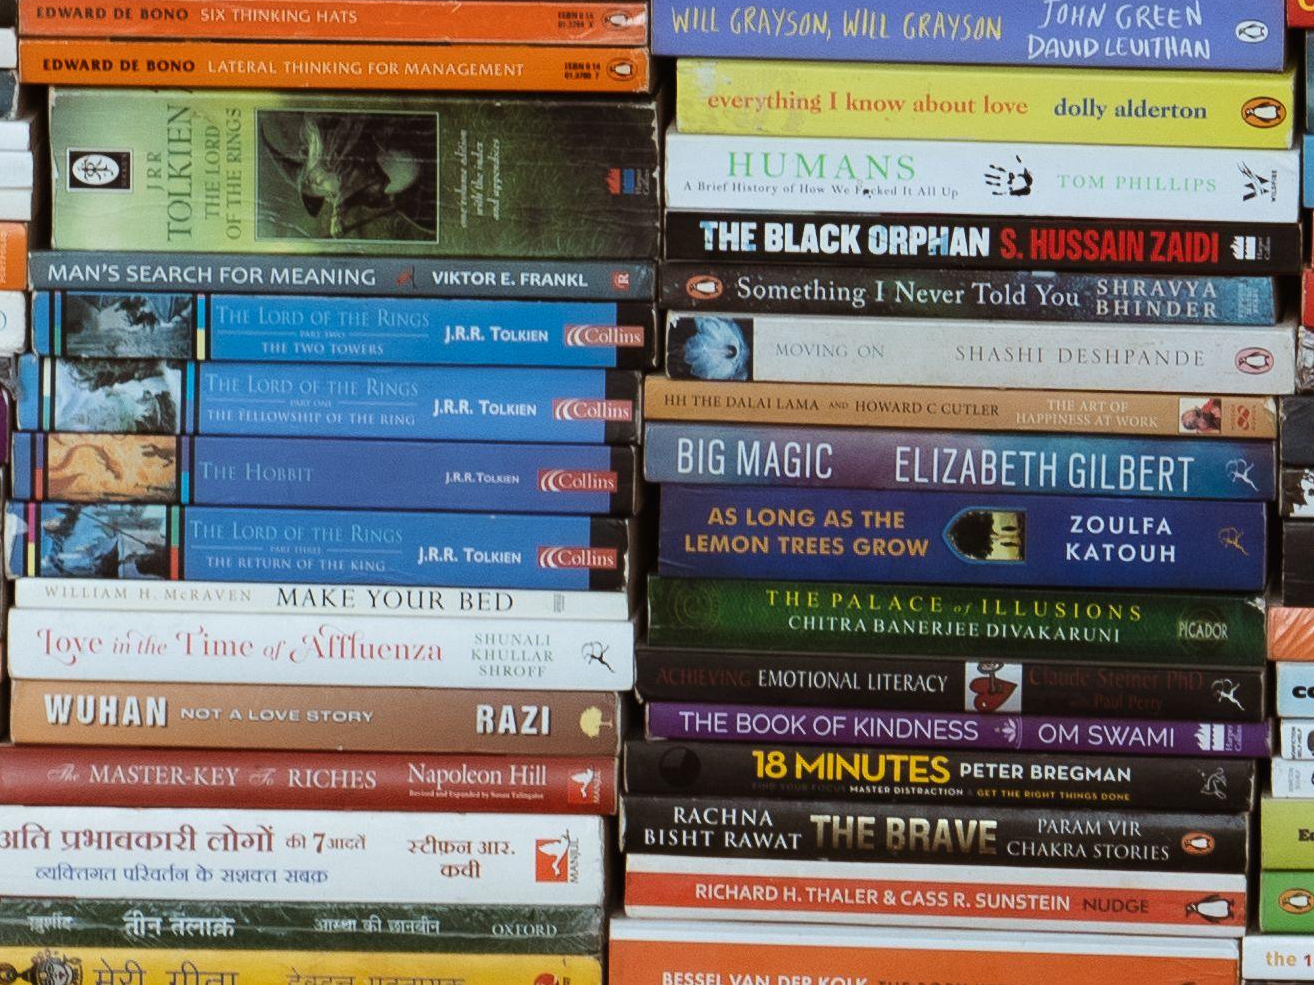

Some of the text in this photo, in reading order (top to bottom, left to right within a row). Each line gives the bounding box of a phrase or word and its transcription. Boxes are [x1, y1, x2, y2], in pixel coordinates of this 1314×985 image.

[1053, 97, 1207, 120] dolly alderton
[431, 270, 588, 288] VIKTOR E. FRANKL
[585, 327, 641, 346] Collins
[955, 344, 1206, 367] SHASHI DESHPANDE
[474, 633, 551, 648] SHUNALI
[470, 647, 555, 663] KHULLAR
[478, 664, 547, 678] SHROFF
[475, 704, 550, 735] RAZI
[1038, 723, 1175, 748] OM SWAMI
[960, 762, 1131, 782] PETER BREGMAN
[1082, 896, 1150, 914] NUDGE
[491, 922, 558, 938] OXFORD
